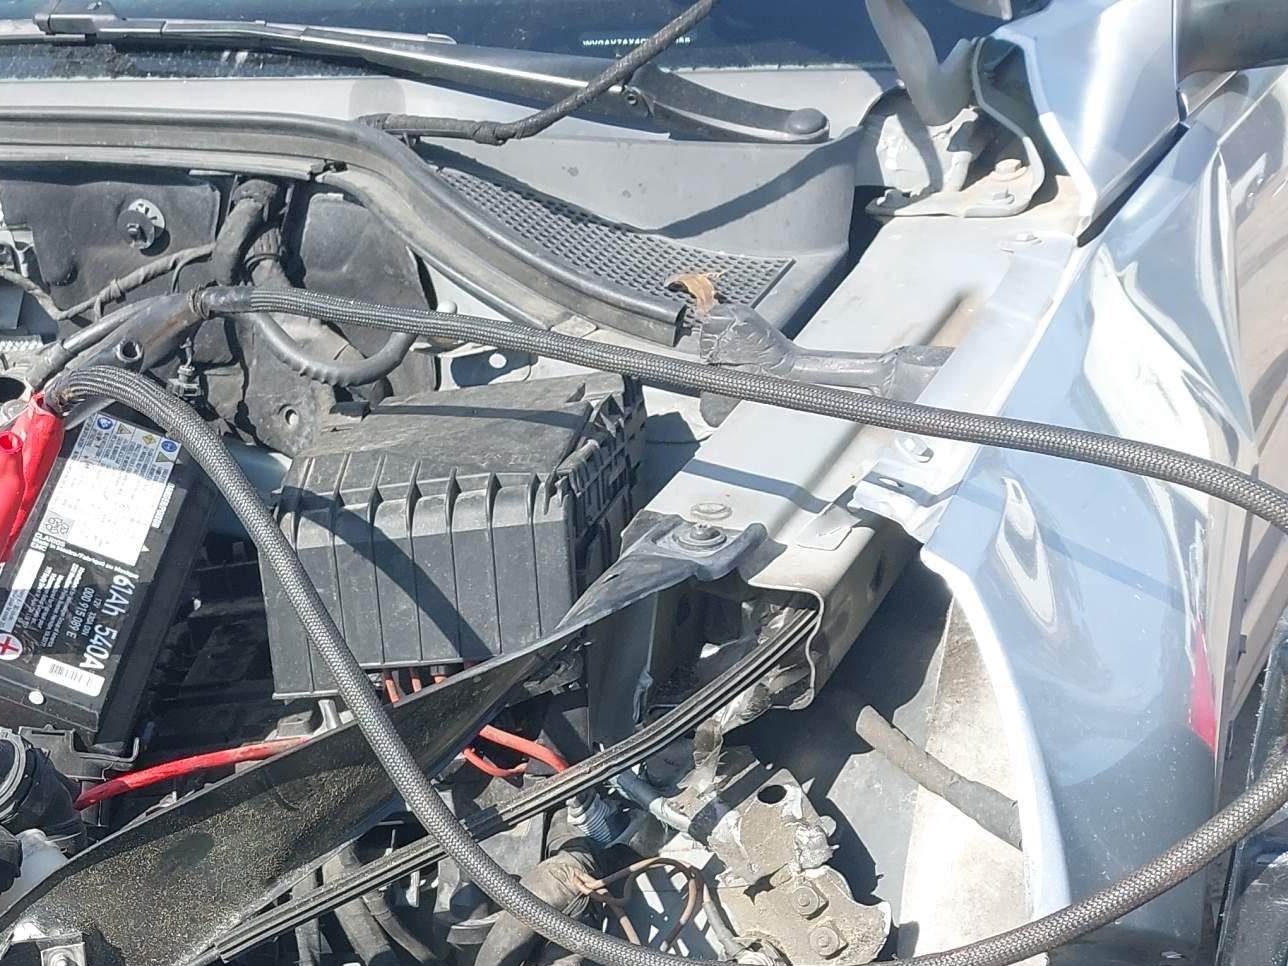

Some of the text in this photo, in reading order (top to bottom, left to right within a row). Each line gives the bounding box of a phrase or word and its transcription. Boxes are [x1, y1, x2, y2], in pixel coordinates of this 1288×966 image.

[66, 587, 95, 639] 000 915 089 E
[79, 574, 135, 669] 61Ah 540A
